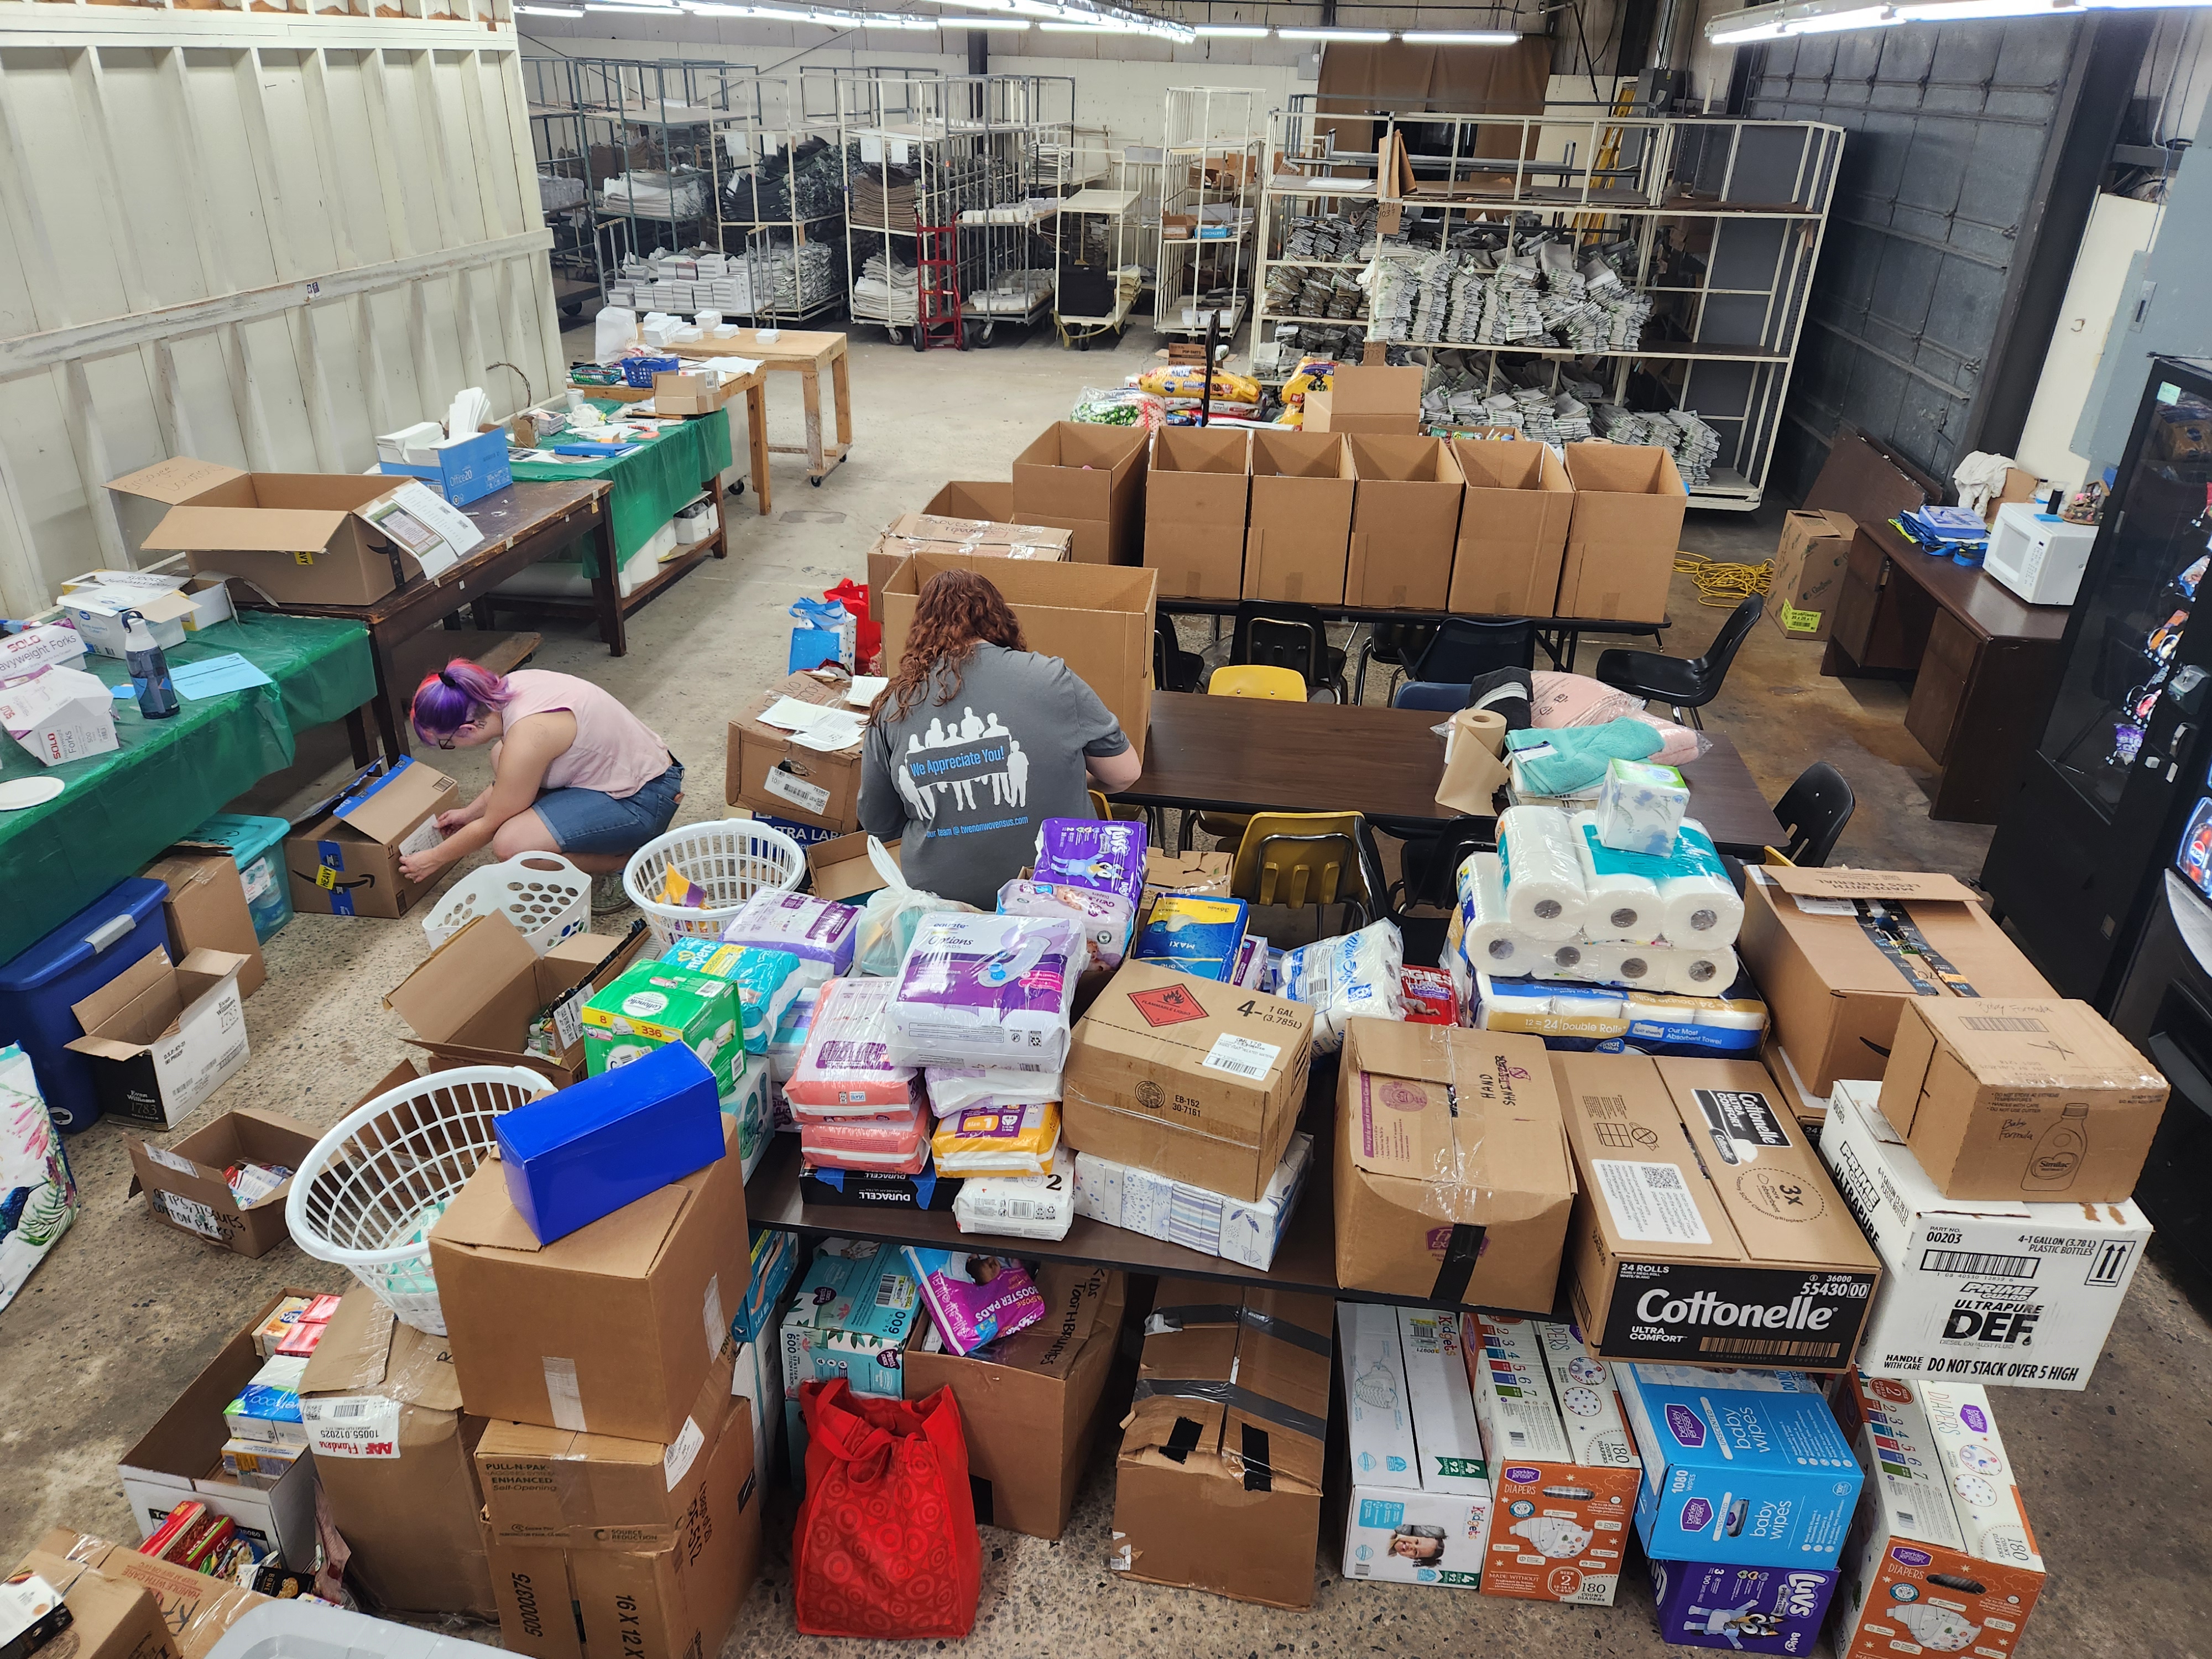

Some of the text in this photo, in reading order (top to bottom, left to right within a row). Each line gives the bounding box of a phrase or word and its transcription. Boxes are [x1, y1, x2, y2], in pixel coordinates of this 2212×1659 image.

[7, 635, 43, 653] SOLO
[49, 634, 76, 650] Forks
[48, 733, 61, 759] SOLO
[65, 731, 76, 754] Forks
[910, 745, 1004, 776] We Appreciate You!
[937, 828, 952, 837] team
[321, 866, 333, 888] HEAVY
[1170, 941, 1195, 950] MAXI
[628, 999, 662, 1011] Cottonelle
[1141, 1000, 1173, 1013] FLAMMABLE
[1276, 1008, 1294, 1018] GAL
[601, 1015, 607, 1024] 8
[1262, 1013, 1303, 1030] (3.785L)
[1543, 1019, 1558, 1030] 24
[1562, 1022, 1597, 1032] Double
[641, 1026, 662, 1038] 336
[1666, 1033, 1723, 1045] Absorbent Towel
[1480, 1074, 1496, 1099] HAND
[131, 1102, 157, 1116] 1783
[1175, 1094, 1199, 1108] EB-152
[1727, 1093, 1745, 1117] ULTRA
[1172, 1103, 1201, 1117] 30-7161
[1717, 1092, 1742, 1128] COMFORT
[984, 1117, 992, 1129] 1
[1738, 1094, 1777, 1145] Cottonelle
[1999, 1130, 2033, 1140] Formula
[1840, 1140, 1880, 1207] PRIME
[1046, 1174, 1063, 1191] 2
[859, 1192, 911, 1202] DURACELL
[1768, 1185, 1781, 1199] more
[1779, 1183, 1804, 1207] 3x
[1834, 1161, 1880, 1245] ULTRAPURE
[1926, 1233, 1963, 1244] 00203
[2034, 1237, 2064, 1246] GALLON
[2065, 1239, 2086, 1248] (3.78
[2028, 1244, 2093, 1256] PLASTIC BOTTLES
[1636, 1264, 1670, 1273] ROLLS
[1827, 1275, 1852, 1283] 36000
[1800, 1282, 1867, 1297] 55430 00
[1961, 1282, 2037, 1297] PRIME
[1981, 1293, 2029, 1301] GUARD
[975, 1302, 1000, 1322] PADS
[1637, 1288, 1834, 1331] Cottonelle
[1954, 1300, 2044, 1314] ULTRAPURE
[889, 1311, 906, 1334] 600
[1631, 1326, 1665, 1335] ULTRA
[787, 1333, 796, 1353] 600
[1438, 1315, 1457, 1356] Kidgets
[1629, 1333, 1683, 1343] COMFORT
[1884, 1361, 1922, 1370] WITH CARE
[1886, 1354, 1923, 1363] HANDLE
[1927, 1357, 2079, 1381] DO NOT STACK OVER 5 HIGH
[1887, 1384, 1902, 1397] 2
[1928, 1391, 1960, 1436] DIAPERS
[320, 1430, 379, 1439] 10055.012025
[1707, 1409, 1726, 1447] UNSCENTED
[1723, 1407, 1753, 1449] baby
[1745, 1406, 1771, 1453] wipes
[319, 1441, 393, 1455] AAF Flanders
[1598, 1441, 1608, 1464] DIAPERS
[1604, 1443, 1614, 1462] COUNT
[1611, 1443, 1630, 1464] 180
[486, 1463, 548, 1472] PULL-N-PAK
[1449, 1461, 1458, 1473] 92
[1465, 1462, 1480, 1474] 4
[493, 1484, 557, 1493] Self-Opening
[1504, 1484, 1536, 1495] DIAPERS
[1671, 1470, 1689, 1494] 1080
[1469, 1506, 1485, 1540] Kidgets
[1716, 1502, 1729, 1532] UNSCENTED
[1750, 1500, 1776, 1537] baby
[1770, 1500, 1792, 1540] wipes
[2008, 1537, 2028, 1562] 180
[1888, 1563, 1925, 1580] DIAPERS
[122, 1567, 200, 1600] HANDLE WITH CARE
[264, 1572, 274, 1592] BONE
[1582, 1583, 1606, 1594] 180
[1789, 1572, 1827, 1617] Luvs
[511, 1572, 543, 1637] 50000375
[615, 1595, 643, 1645] 16 X 12
